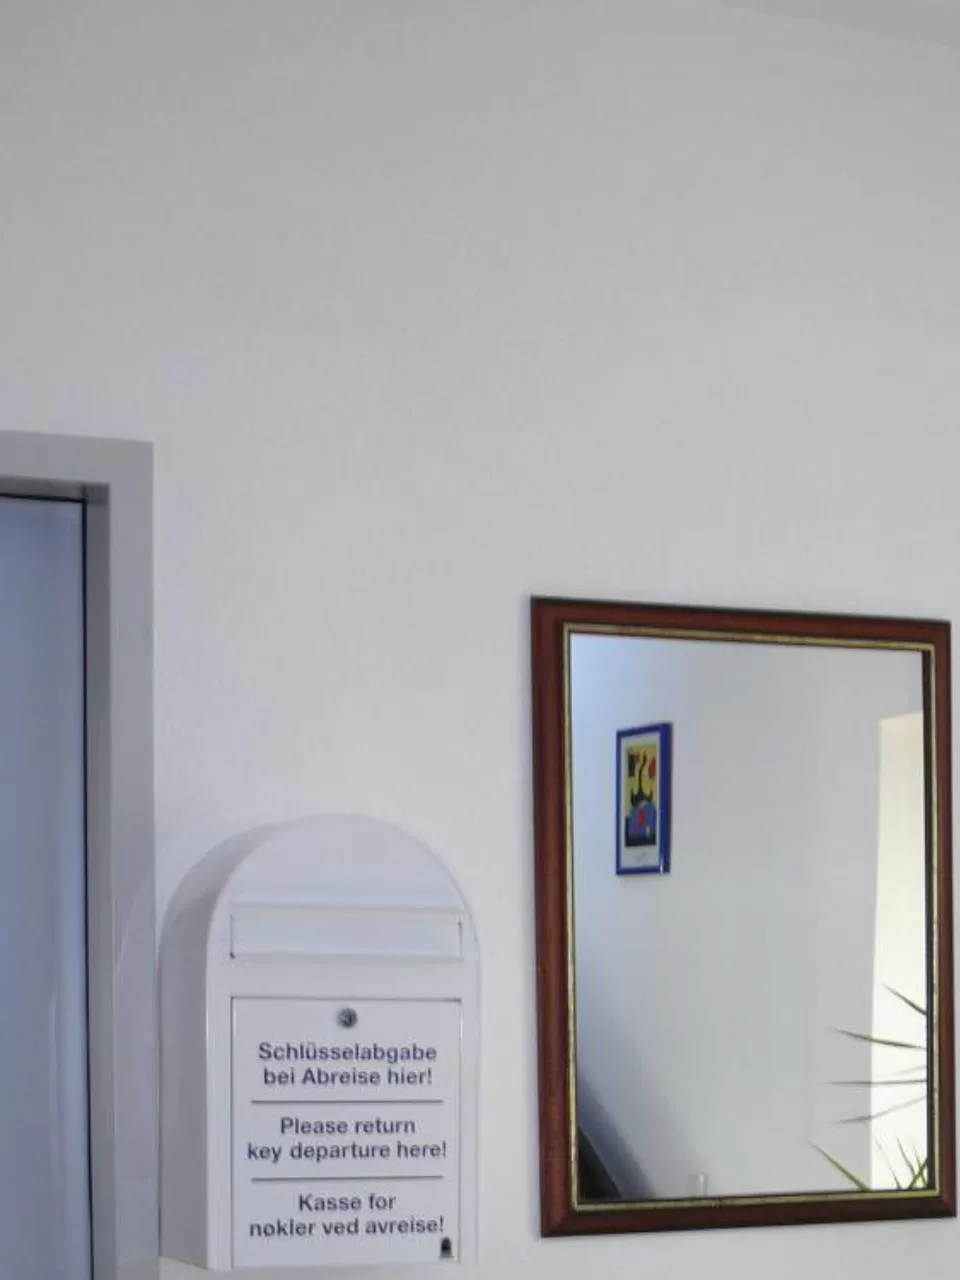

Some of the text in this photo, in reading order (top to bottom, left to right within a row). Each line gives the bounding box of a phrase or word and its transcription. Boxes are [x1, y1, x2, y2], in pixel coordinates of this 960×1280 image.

[258, 1041, 437, 1065] Schlüsselabgabe
[263, 1067, 432, 1086] bei Abreise hier!
[280, 1116, 416, 1135] Please return
[247, 1140, 447, 1164] key departure here!
[298, 1192, 396, 1212] Kasse for
[321, 1217, 359, 1236] ved
[364, 1215, 445, 1234] avreise!
